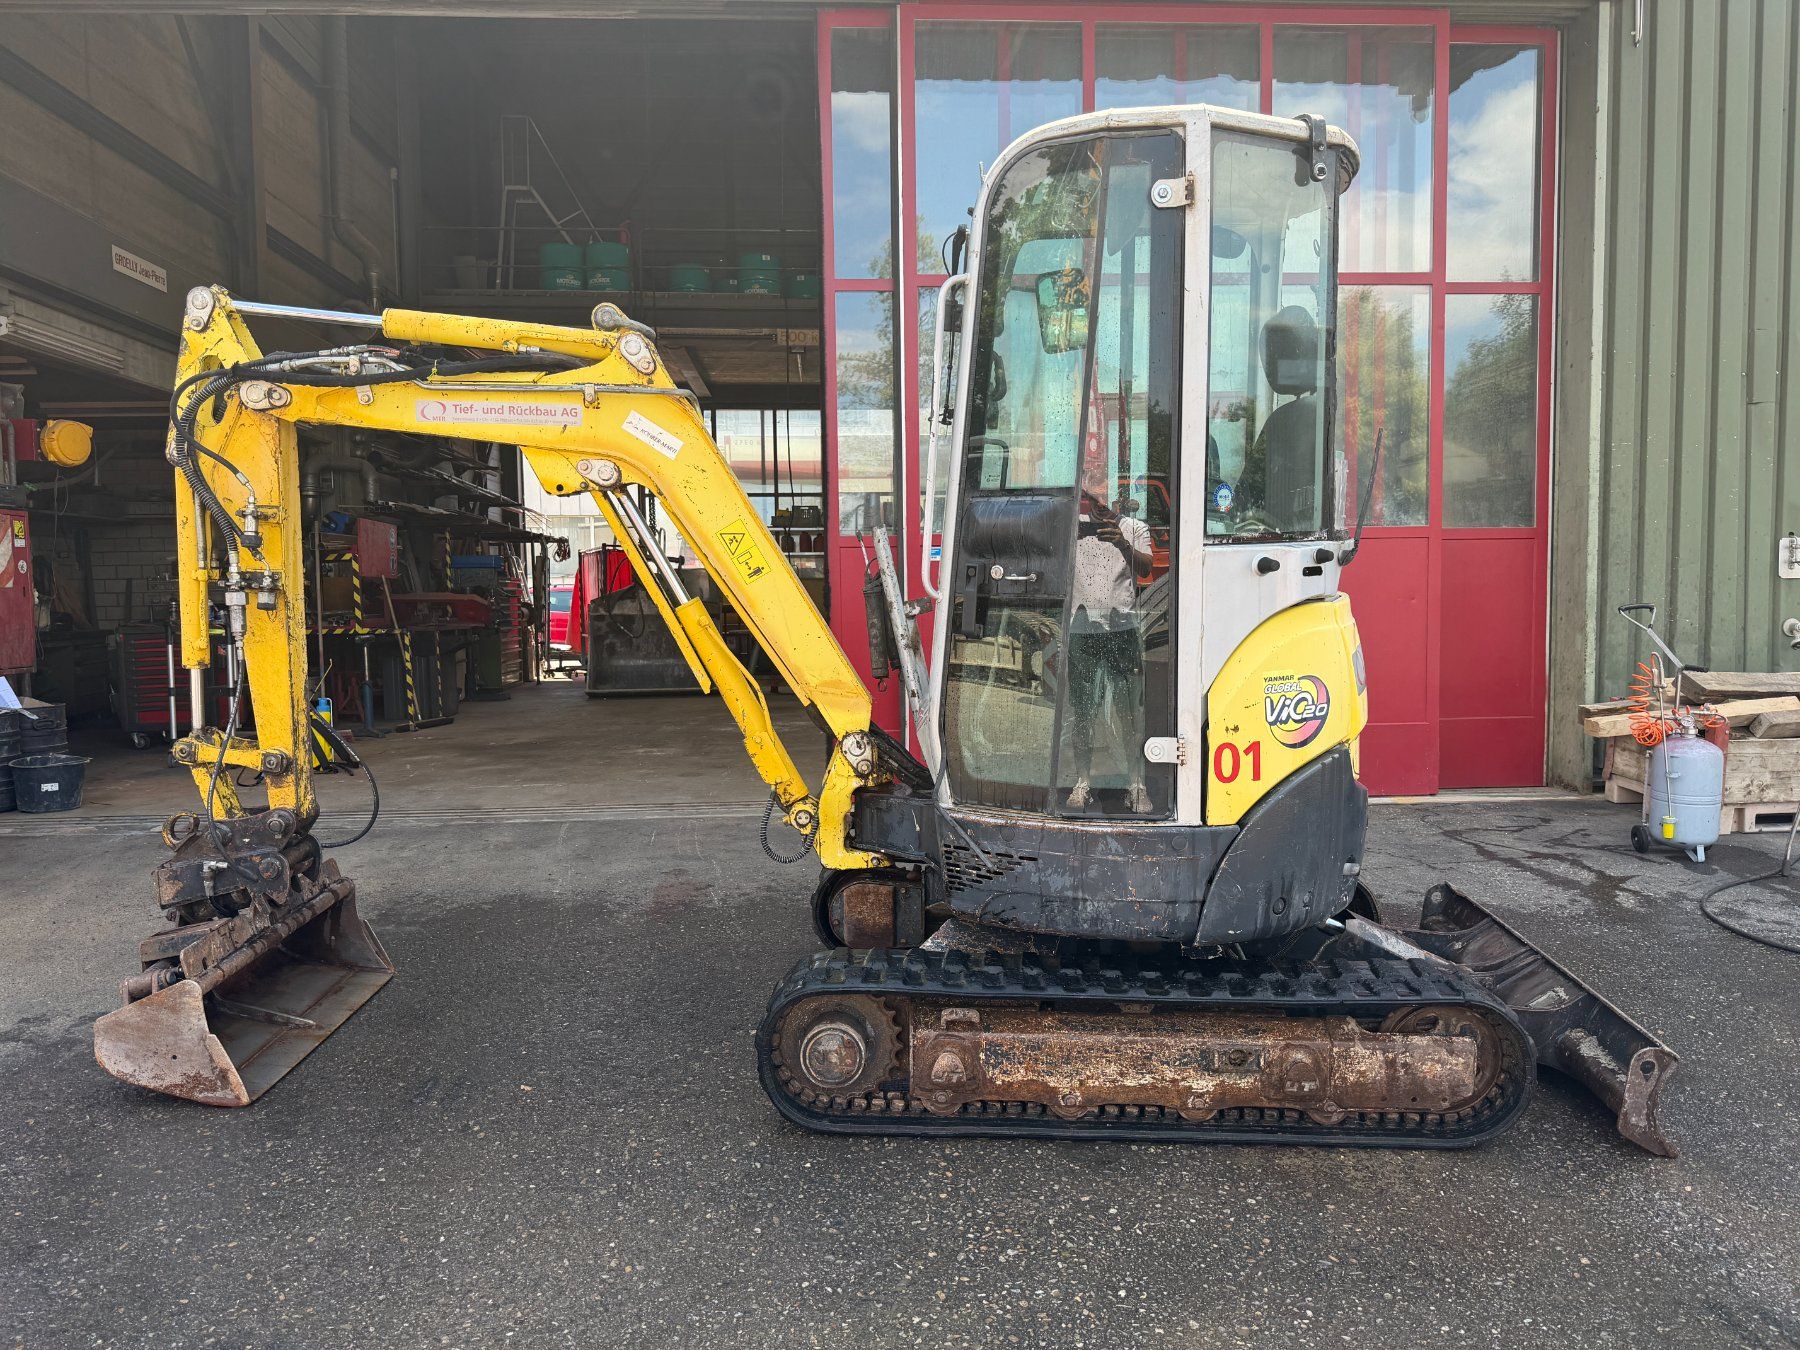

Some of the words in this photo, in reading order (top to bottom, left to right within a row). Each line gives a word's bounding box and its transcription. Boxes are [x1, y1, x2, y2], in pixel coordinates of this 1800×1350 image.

[452, 404, 478, 414] Tief-
[482, 405, 504, 415] und
[508, 405, 557, 417] Rückbau
[561, 407, 578, 418] AG
[1263, 675, 1295, 683] YANMAR
[1264, 681, 1302, 694] GLOBAL
[1264, 690, 1328, 726] ViO20
[1214, 741, 1260, 784] 01
